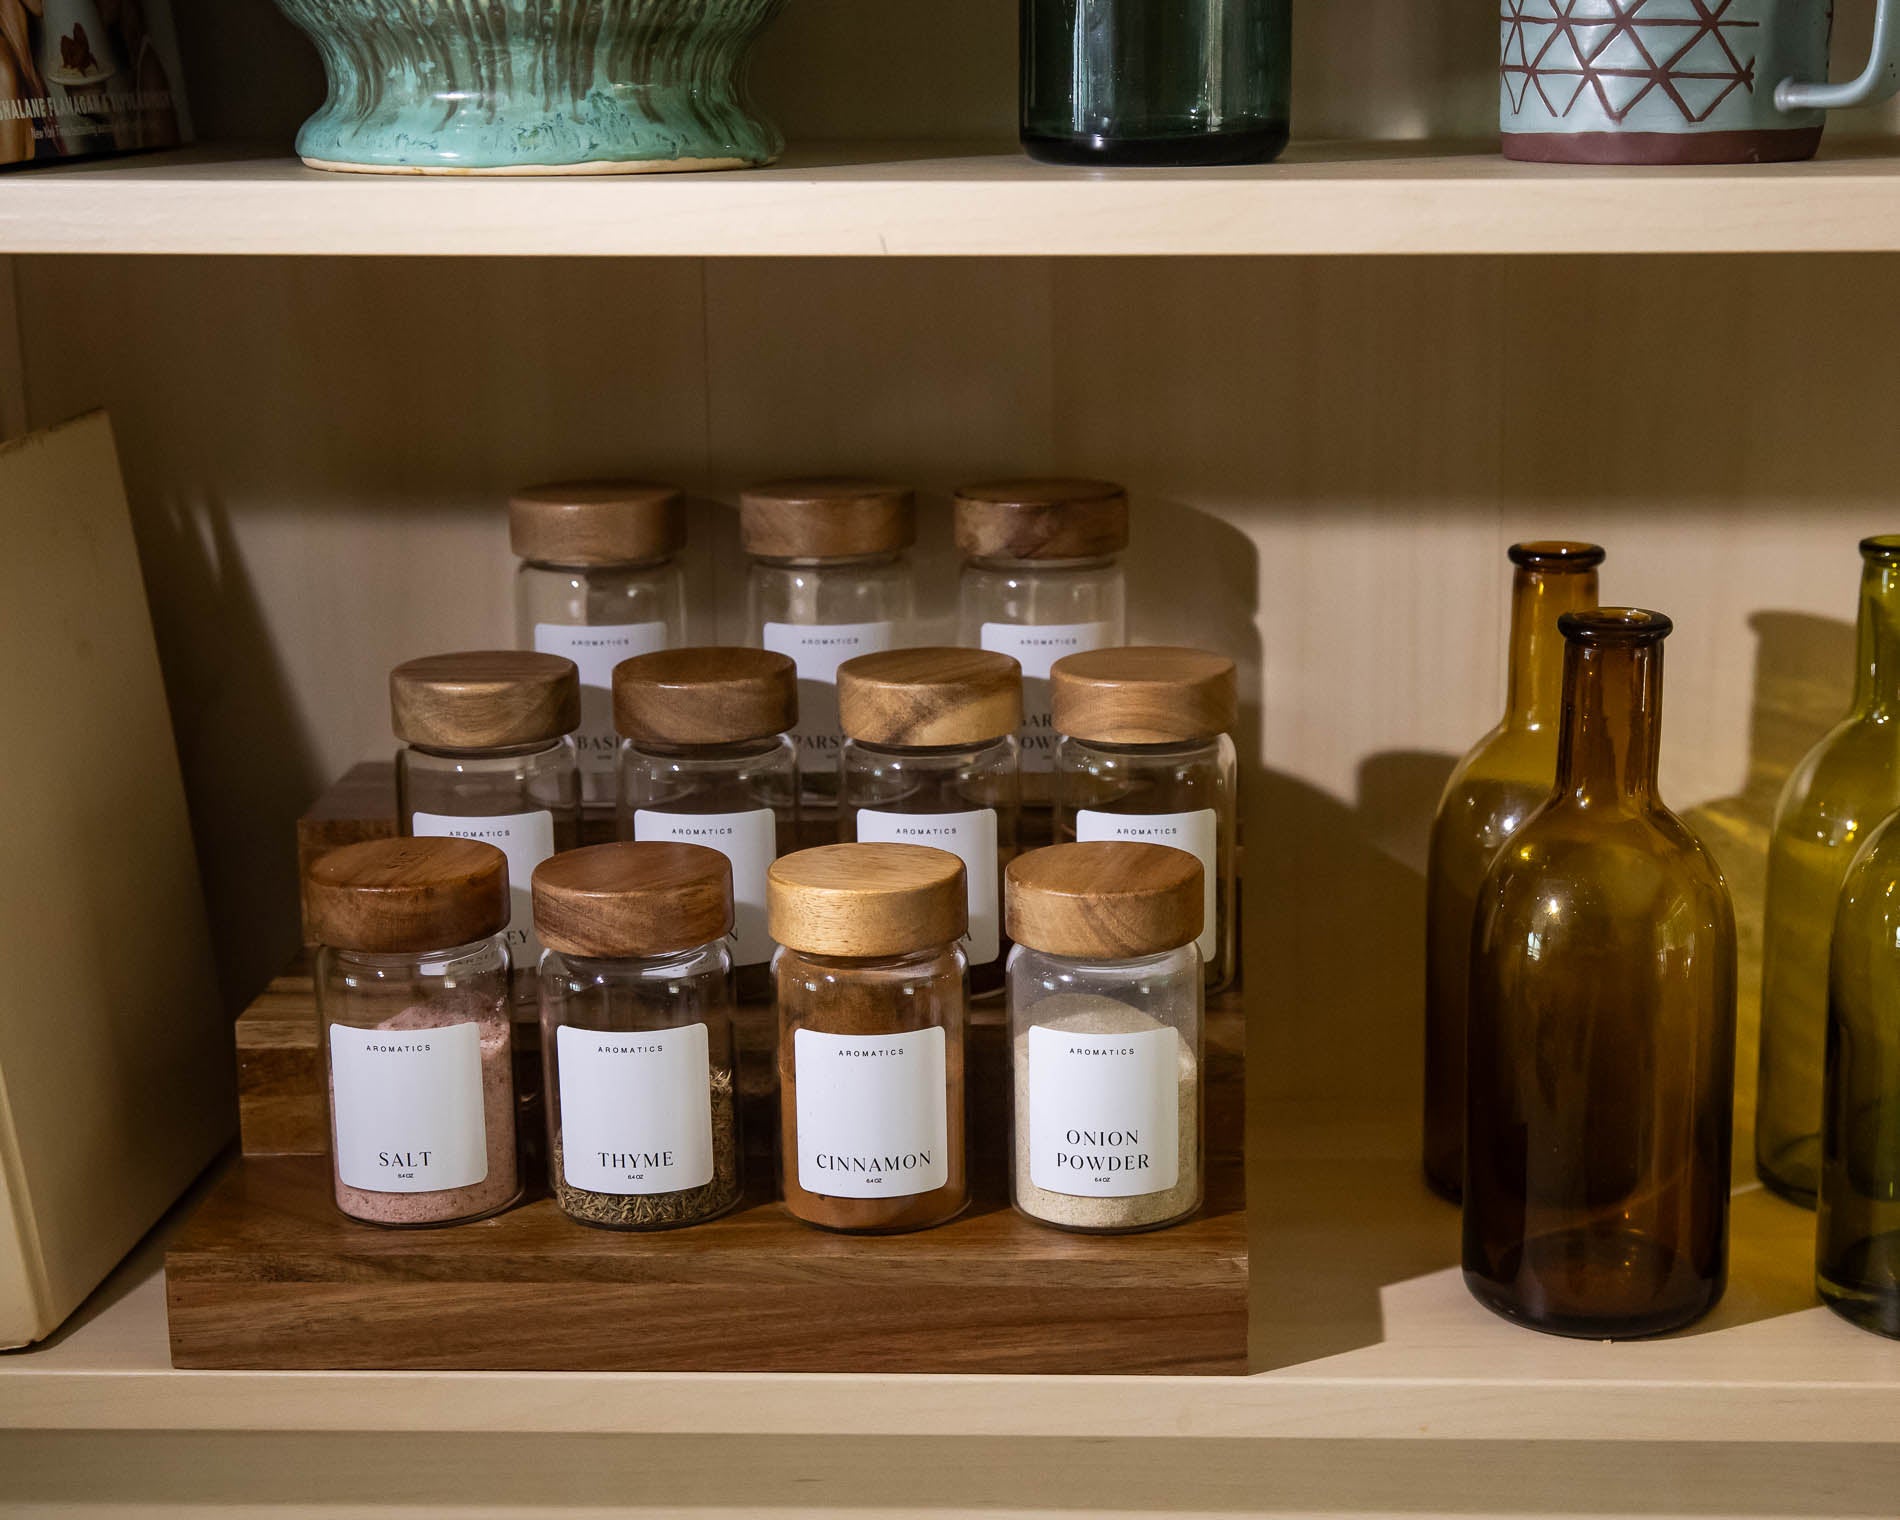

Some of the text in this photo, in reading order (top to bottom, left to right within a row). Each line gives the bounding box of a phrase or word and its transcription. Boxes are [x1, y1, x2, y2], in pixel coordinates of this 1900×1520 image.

[571, 638, 630, 646] AROMATICS
[801, 638, 860, 646] AROMATICS
[1020, 638, 1078, 646] AROMATICS
[449, 830, 510, 838] AROMATICS
[672, 828, 734, 836] AROMATICS
[896, 828, 958, 836] AROMATICS
[1116, 828, 1178, 836] AROMATICS
[366, 1044, 431, 1052] AROMATICS
[598, 1045, 663, 1054] AROMATICS
[1069, 1048, 1135, 1056] AROMATICS
[838, 1048, 905, 1057] AROMATICS
[1066, 1129, 1139, 1146] ONION
[379, 1151, 432, 1167] SALT
[598, 1151, 674, 1168] THYME
[816, 1150, 931, 1172] CINNAMON
[1057, 1153, 1150, 1171] POWDER
